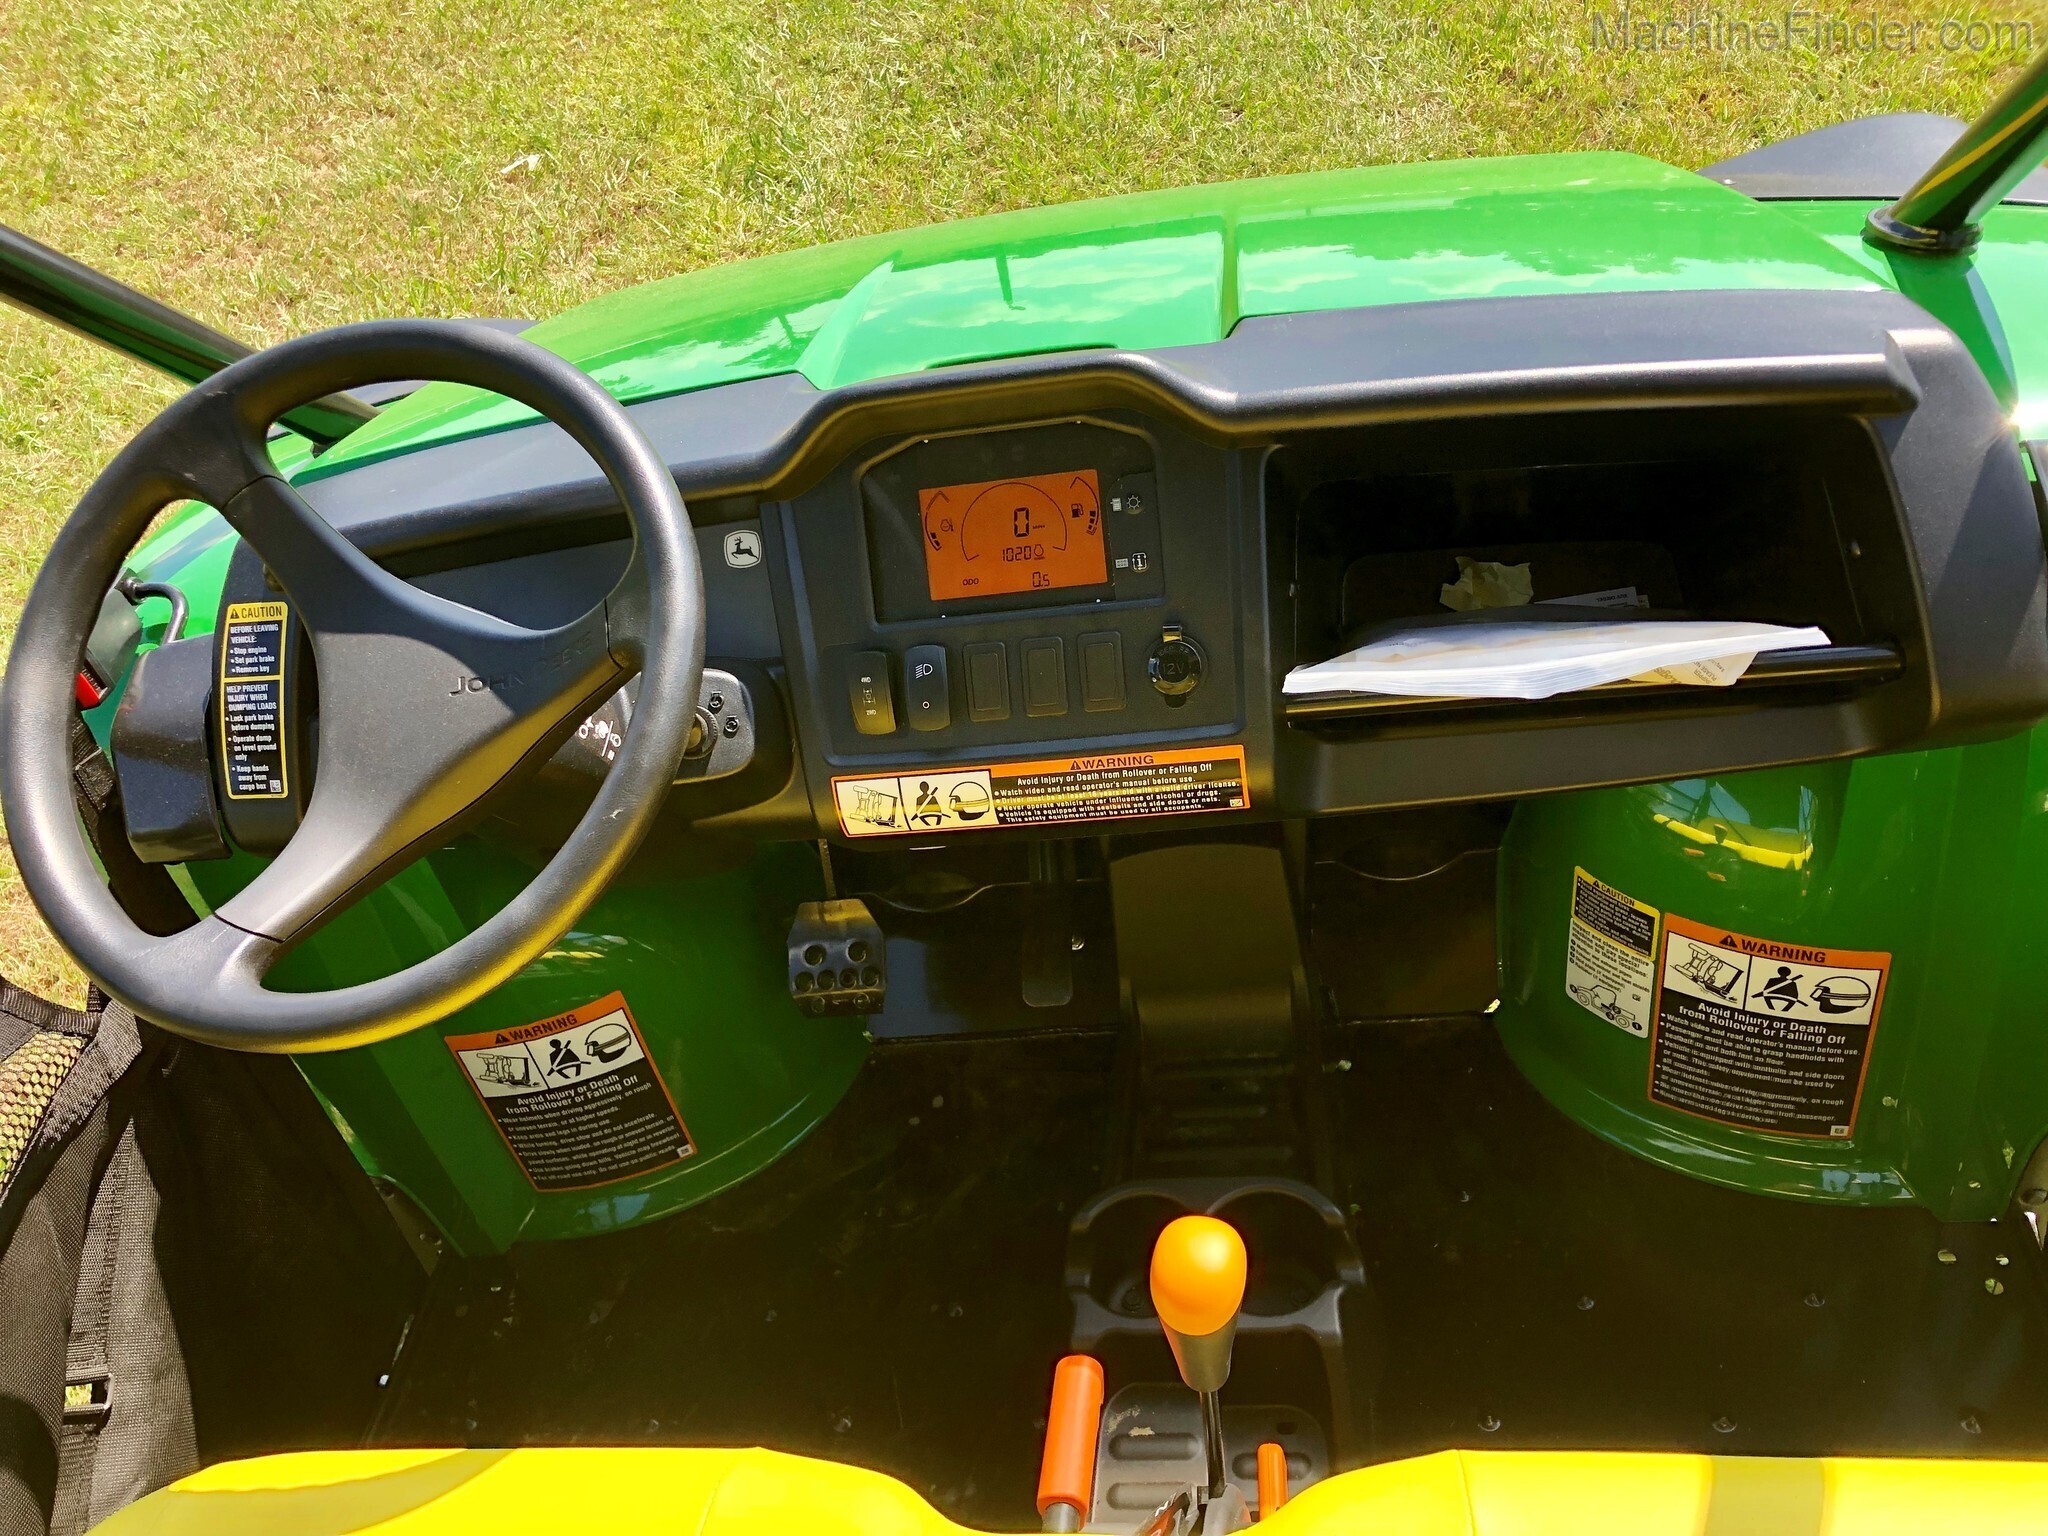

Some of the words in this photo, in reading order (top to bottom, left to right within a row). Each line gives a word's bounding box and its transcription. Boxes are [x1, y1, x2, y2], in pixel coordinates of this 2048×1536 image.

[1014, 507, 1029, 537] 0
[1002, 546, 1032, 562] 1020
[1032, 572, 1050, 587] 0.5
[242, 605, 282, 618] CAUTION
[254, 624, 278, 632] LEAVING
[248, 646, 267, 654] engine
[246, 656, 258, 664] park
[1163, 663, 1184, 674] 12V
[243, 684, 269, 692] PREVENT
[228, 694, 248, 702] INJURY
[229, 703, 256, 711] DUMPING
[245, 714, 257, 722] park
[250, 723, 274, 731] dumping
[233, 735, 254, 743] Operate
[257, 744, 277, 752] ground
[1082, 755, 1154, 769] WARNING
[1018, 776, 1038, 785] Avoid
[1041, 775, 1063, 784] Injury
[1077, 772, 1099, 780] Death
[1123, 769, 1156, 777] Rollover
[1170, 765, 1197, 773] Falling
[1200, 763, 1212, 771] Off
[1000, 788, 1022, 796] Watch
[1082, 781, 1119, 791] operator's
[1123, 779, 1150, 787] manual
[1027, 794, 1044, 802] must
[1067, 791, 1086, 799] least
[1099, 790, 1119, 798] years
[1136, 786, 1152, 794] with
[1162, 784, 1180, 792] valid
[1027, 802, 1054, 810] operate
[1056, 799, 1083, 807] vehicle
[1156, 792, 1184, 800] alcohol
[1043, 806, 1077, 815] equipped
[1097, 802, 1132, 810] seatbelts
[1049, 811, 1086, 820] equipment
[1164, 803, 1204, 811] occupants.
[1602, 884, 1635, 906] CAUTION
[1741, 939, 1826, 963] WARNING
[1680, 1006, 1705, 1019] from
[1710, 1015, 1759, 1033] Rollover
[1780, 1030, 1823, 1043] Falling
[1827, 1035, 1846, 1044] Off
[1698, 1002, 1730, 1017] Avoid
[1735, 1012, 1769, 1028] Injury
[1773, 1021, 1786, 1029] or
[1790, 1022, 1826, 1033] Death
[509, 1014, 577, 1040] WARNING
[1667, 1013, 1688, 1025] Watch
[1690, 1021, 1709, 1031] video
[1727, 1032, 1743, 1040] read
[1746, 1036, 1783, 1047] operator's
[1786, 1043, 1815, 1051] manual
[1817, 1046, 1841, 1054] before
[1724, 1039, 1733, 1047] be
[1735, 1042, 1751, 1051] able
[1762, 1048, 1784, 1057] grasp
[1786, 1051, 1825, 1061] handholds
[506, 1105, 529, 1114] from
[531, 1098, 572, 1112] Rollover
[587, 1083, 622, 1099] Falling
[623, 1075, 638, 1086] Off
[517, 1095, 544, 1105] Avoid
[546, 1088, 575, 1100] Injury
[589, 1075, 619, 1089] Death
[561, 1105, 583, 1115] driving
[634, 1082, 651, 1093] rough
